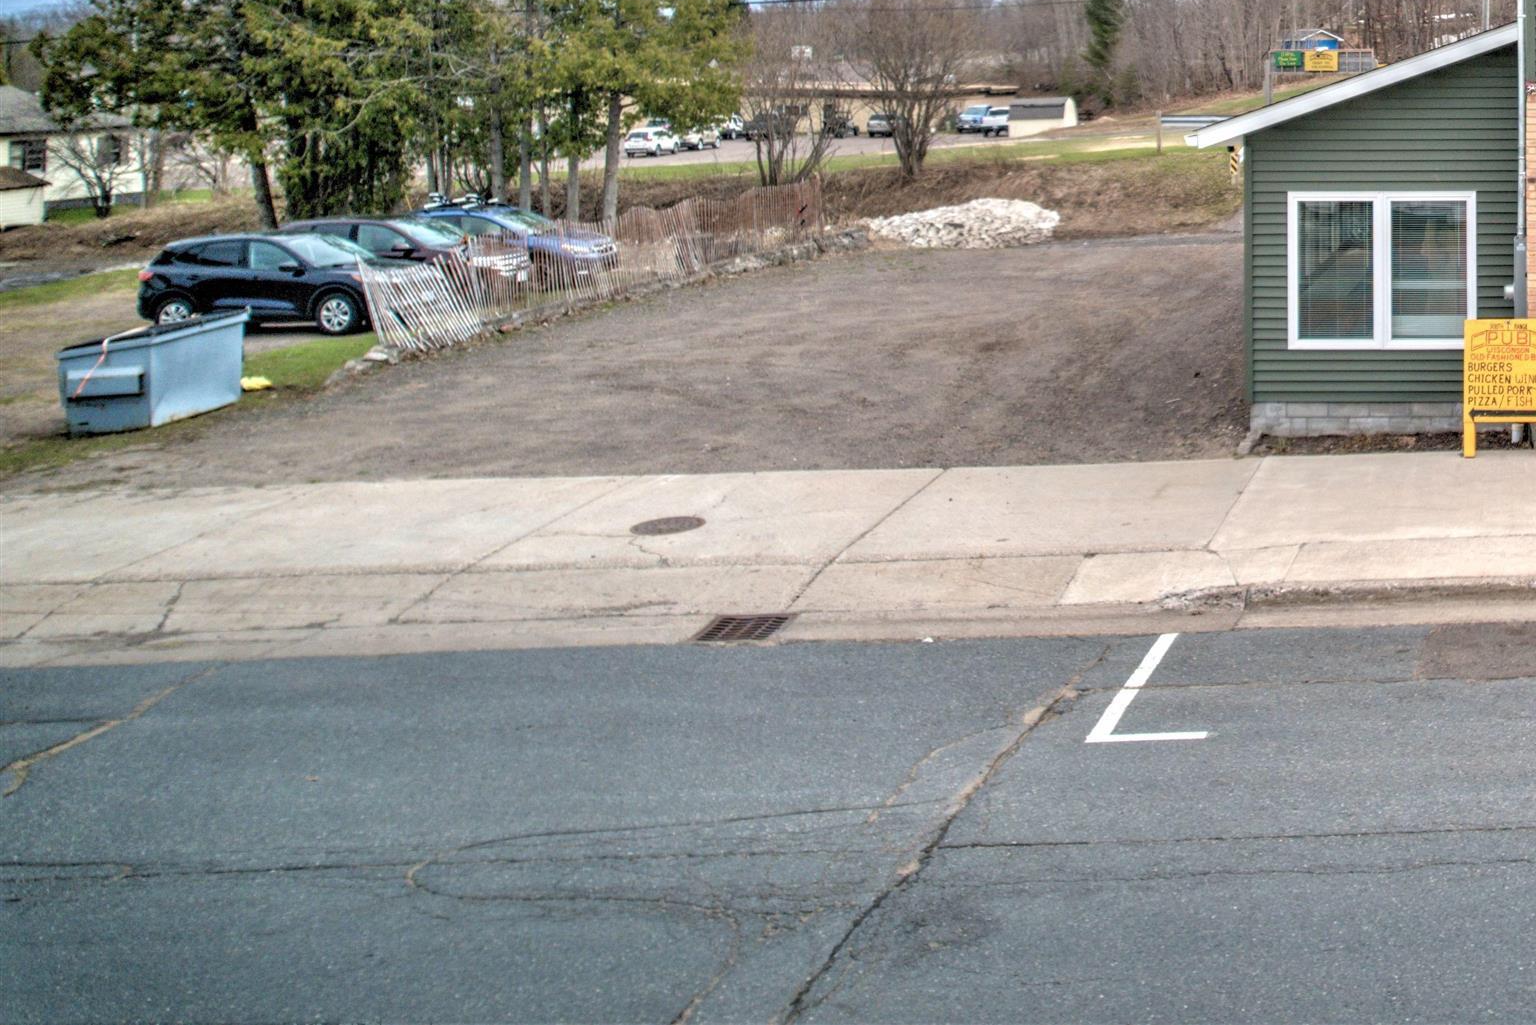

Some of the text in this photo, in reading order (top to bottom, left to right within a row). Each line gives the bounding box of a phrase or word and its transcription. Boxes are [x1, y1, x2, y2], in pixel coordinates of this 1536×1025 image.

[1487, 331, 1528, 345] PUB
[1467, 362, 1513, 372] BURGERS
[1467, 374, 1511, 384] CHICKEN
[1468, 385, 1533, 395] PULLED PORK
[1467, 396, 1498, 407] PIZZA
[1506, 396, 1533, 407] FISH
